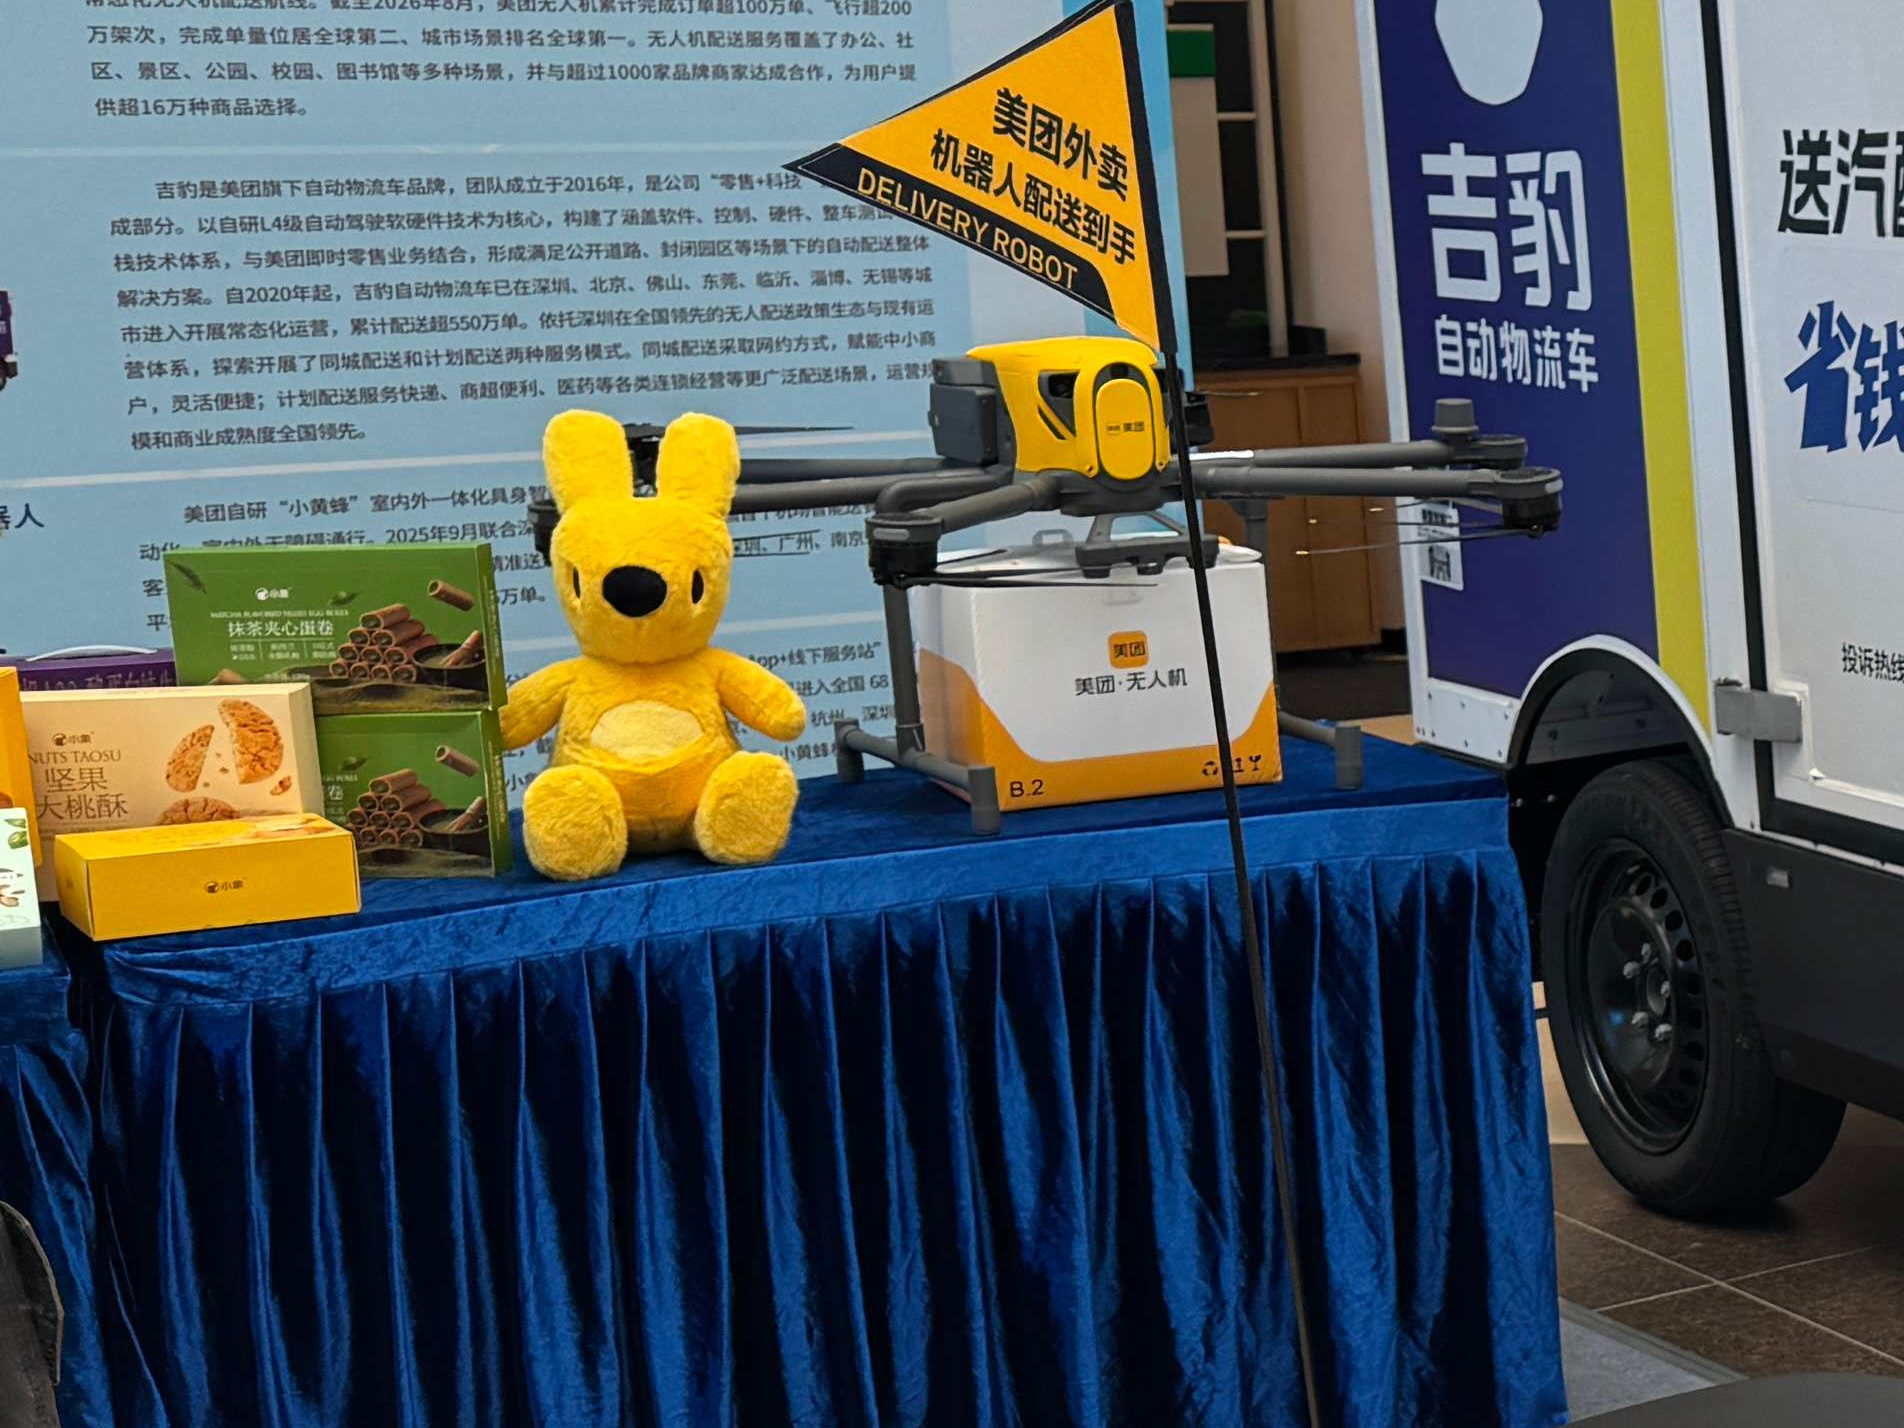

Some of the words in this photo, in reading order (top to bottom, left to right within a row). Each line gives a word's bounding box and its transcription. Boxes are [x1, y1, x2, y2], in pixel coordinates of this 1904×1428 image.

[993, 87, 1129, 202] 美团外卖
[931, 128, 1136, 266] 机器人配送到手
[857, 167, 989, 244] DELIVERY
[993, 227, 1078, 289] ROBOT
[1420, 141, 1592, 312] 吉豹
[1434, 314, 1599, 394] 自动物流车
[228, 619, 335, 637] 抹茶夹心蛋卷
[1113, 640, 1147, 659] 美团
[1075, 667, 1189, 697] 美团·无人机
[73, 749, 122, 763] TAOSU
[45, 765, 108, 793] 坚果
[1010, 779, 1044, 798] B.2
[37, 792, 129, 821] 大桃酥
